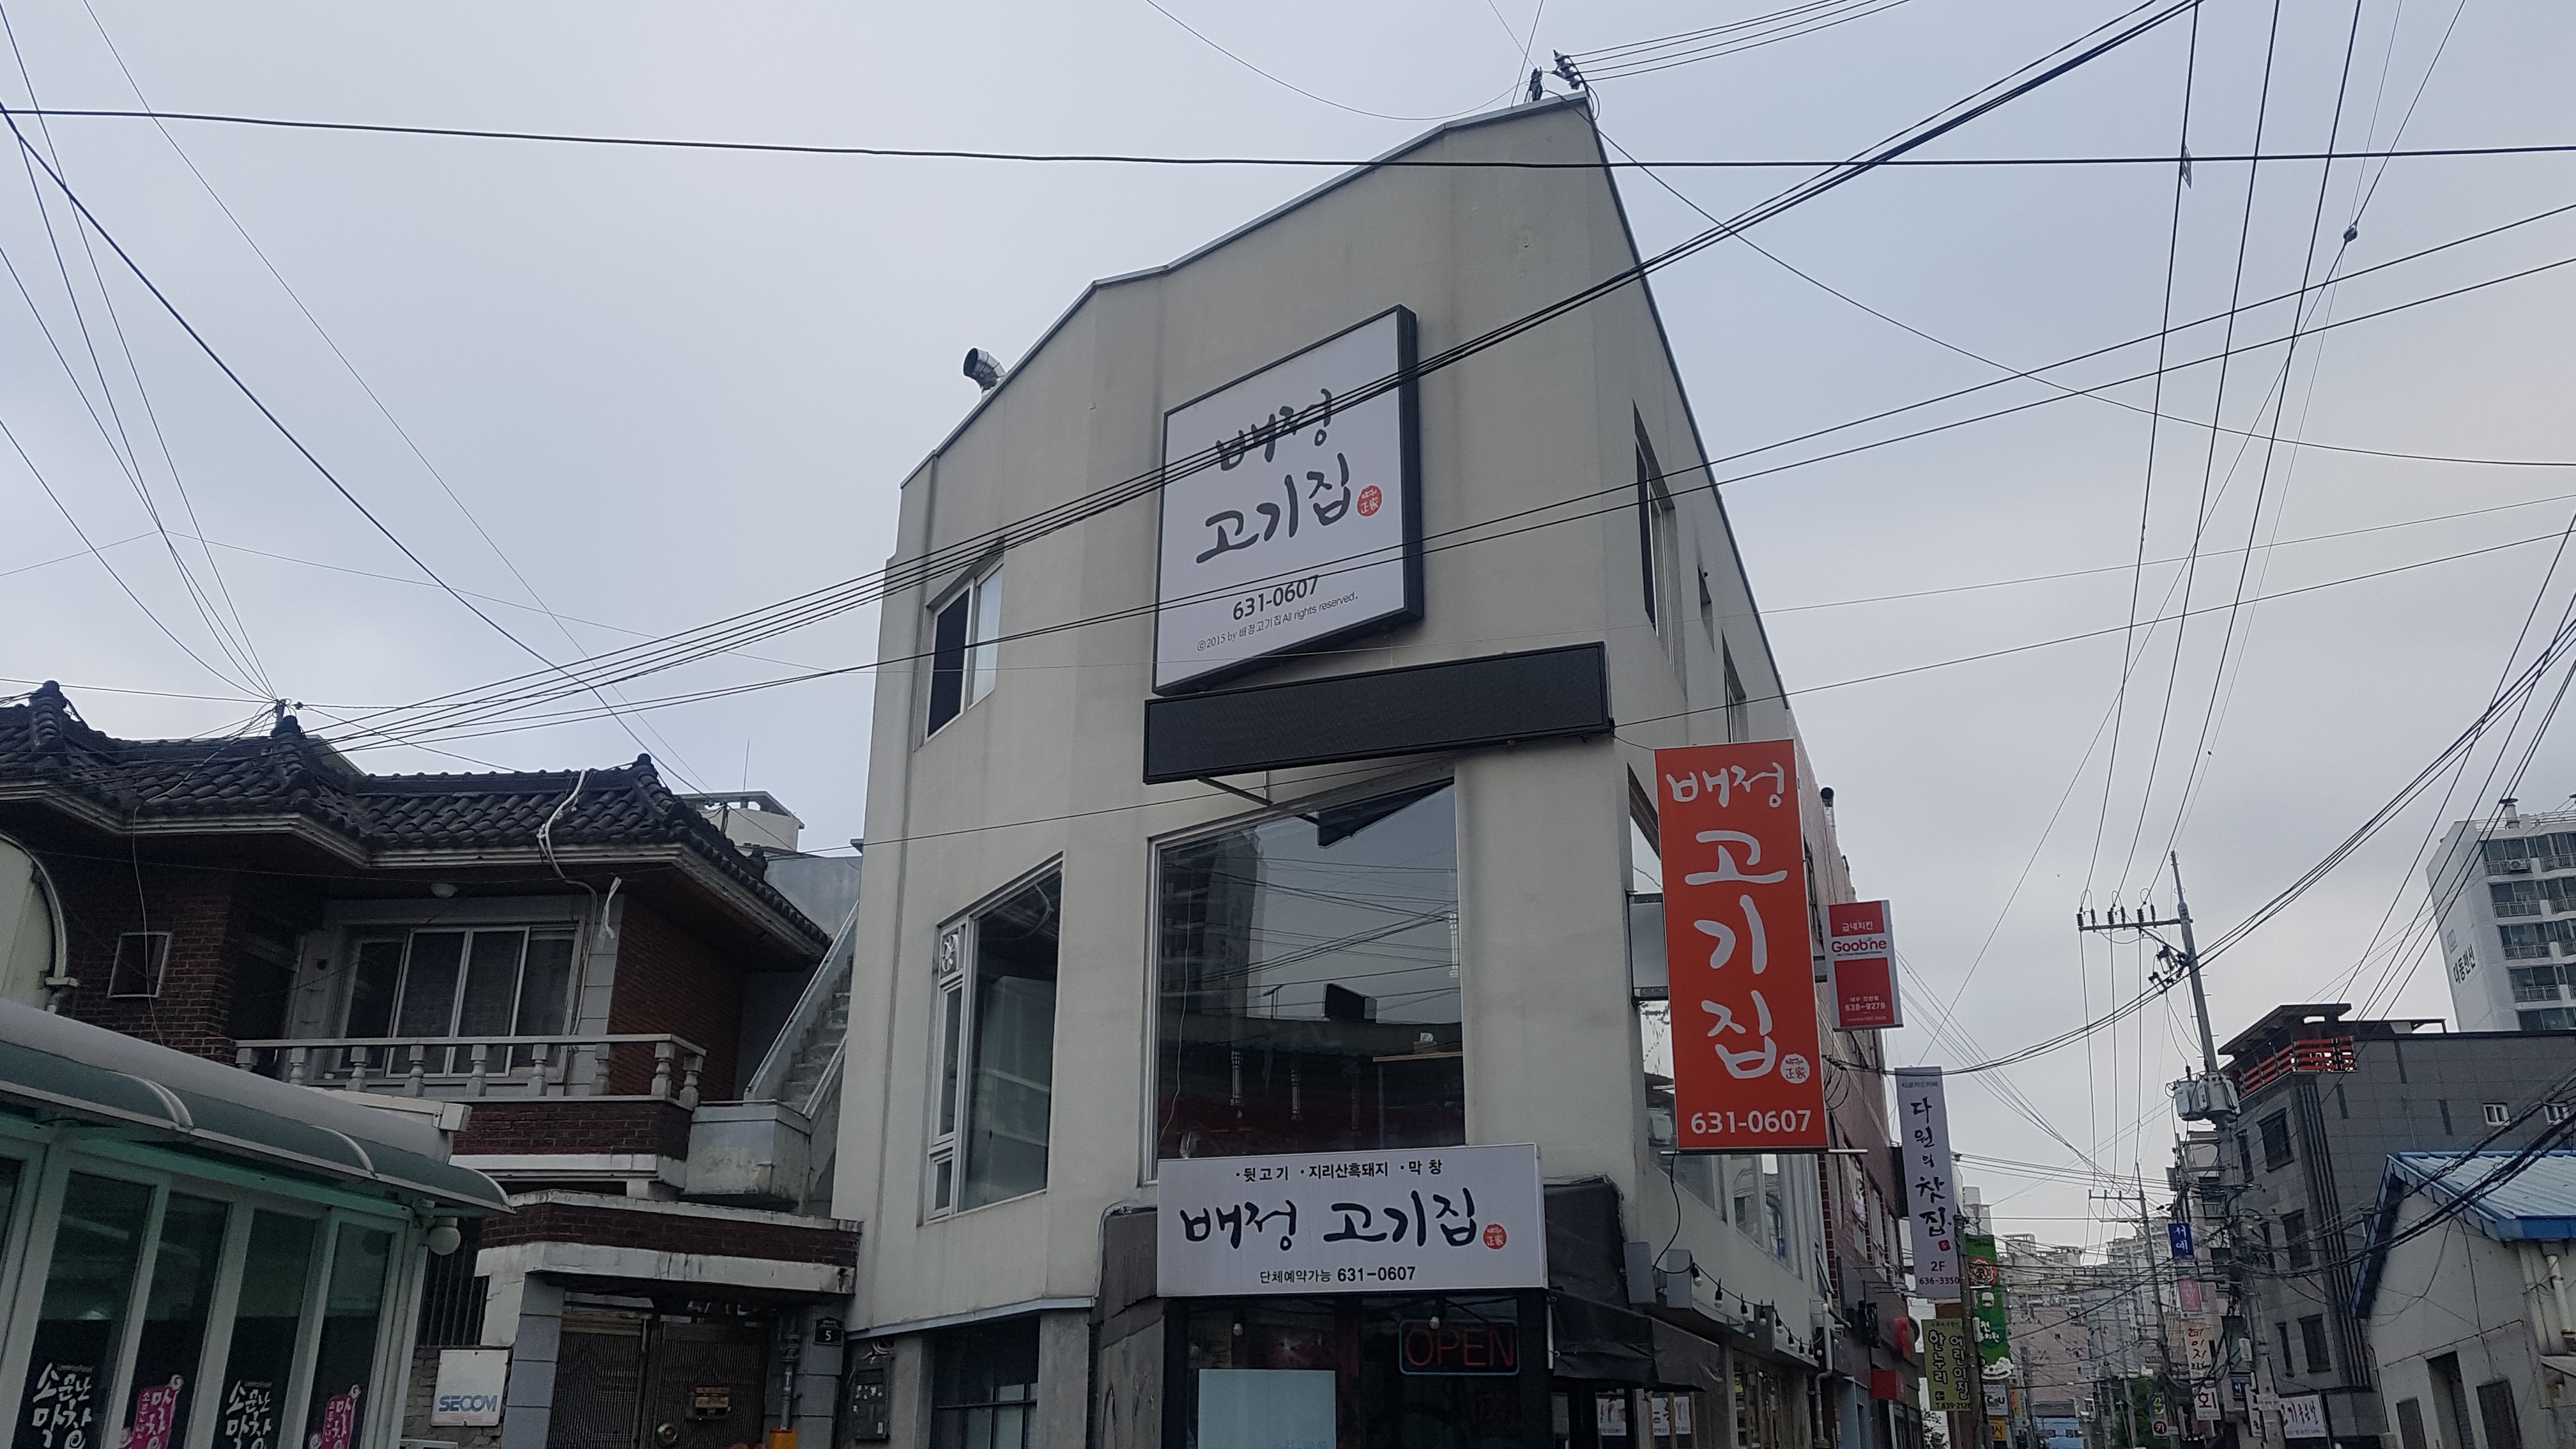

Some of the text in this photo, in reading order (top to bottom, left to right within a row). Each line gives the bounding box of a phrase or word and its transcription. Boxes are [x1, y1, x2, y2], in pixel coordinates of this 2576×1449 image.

[1196, 452, 1351, 564] 고기집
[1227, 632, 1238, 642] by
[1283, 612, 1292, 623] All
[1294, 606, 1317, 620] rights
[1319, 592, 1358, 611] reserved.
[1232, 574, 1319, 621] 631-0607
[1666, 762, 1784, 808] 배정
[1684, 829, 1788, 1080] 고기집
[1690, 1110, 1811, 1135] 631-0607
[1309, 1162, 1388, 1179] 지리산흑돼지
[1179, 1188, 1477, 1252] 배정 고기집
[1260, 1266, 1416, 1284] 단체예약가능 631-0607
[1931, 1261, 1945, 1271] 2F
[825, 1330, 832, 1341] 5
[1407, 1328, 1515, 1367] OPEN
[1928, 1330, 1948, 1385] 한누리
[1949, 1335, 1968, 1400] 어린이집
[438, 1388, 498, 1412] SECOM
[2196, 1392, 2217, 1409] 회
